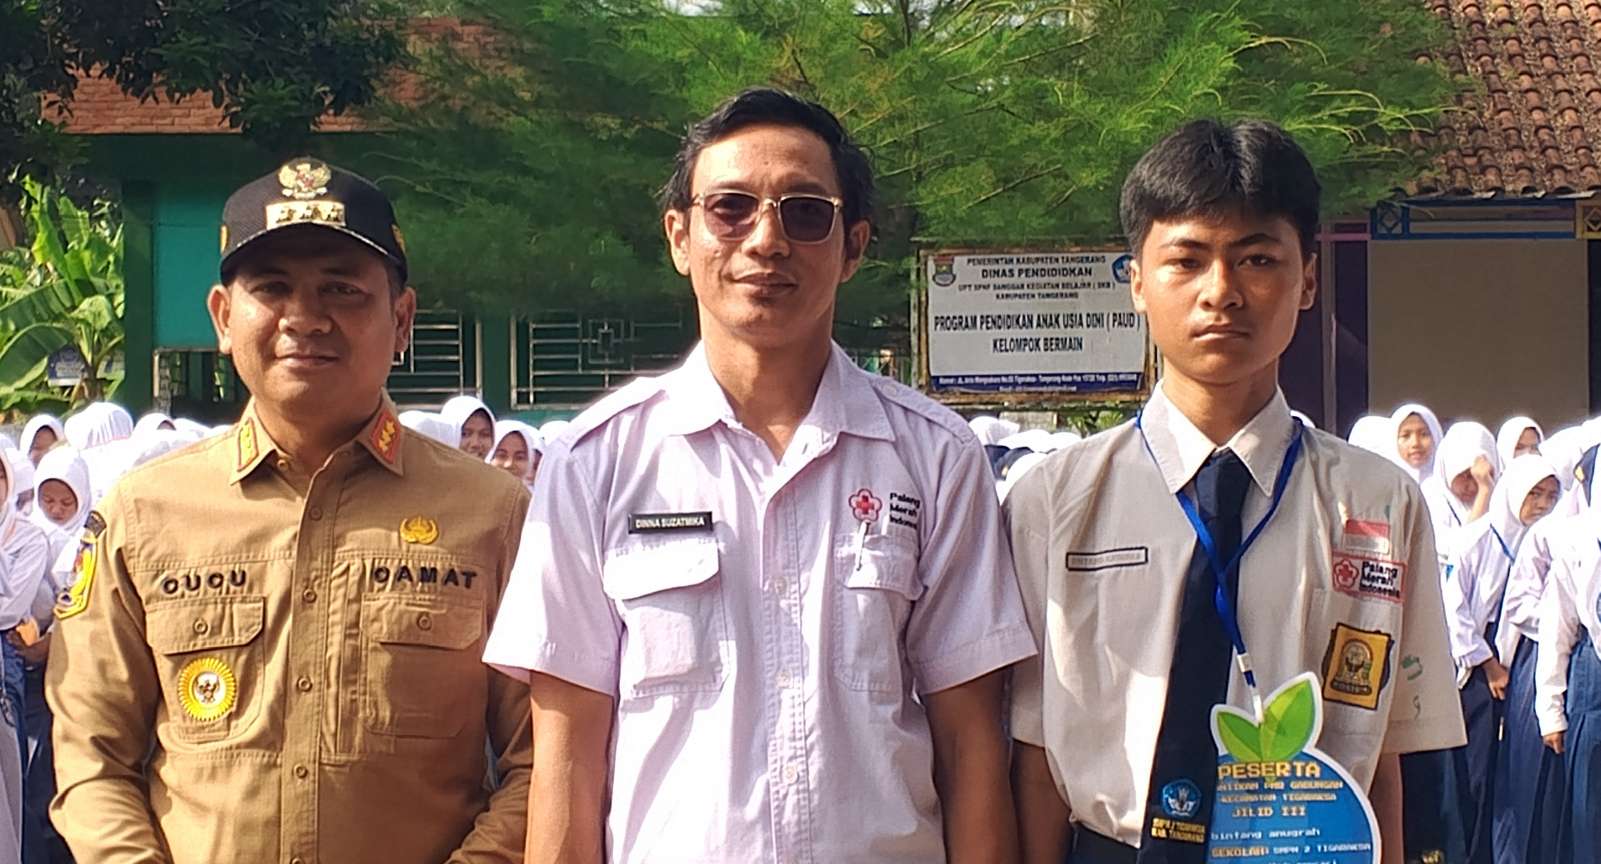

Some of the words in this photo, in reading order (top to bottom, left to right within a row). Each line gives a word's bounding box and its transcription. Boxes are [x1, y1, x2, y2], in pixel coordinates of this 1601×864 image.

[967, 257, 1014, 266] PEMERINTAH
[1016, 256, 1060, 265] KABUPATEN
[1061, 255, 1106, 264] TANGERANG
[981, 268, 1015, 279] DINAS
[1017, 266, 1093, 278] PENDIDIDKAN
[1037, 291, 1079, 299] TANGERANG
[934, 314, 978, 331] PROGRAM
[979, 313, 1034, 331] PENDIDIKAN
[1036, 313, 1060, 329] ANAK
[1062, 312, 1084, 329] USIA
[1086, 312, 1104, 329] DINI
[1112, 311, 1135, 329] PAUD
[992, 337, 1041, 353] KELOMPOK
[1043, 336, 1084, 352] BERMAIN
[889, 492, 921, 510] Palang
[889, 503, 918, 518] Merah
[635, 518, 660, 529] DINNA
[373, 565, 477, 590] CAMAT
[1361, 561, 1398, 579] Palang
[1361, 572, 1394, 587] Merah
[1359, 583, 1400, 599] Indonesia
[1217, 761, 1321, 780] PESERTA
[1232, 806, 1274, 818] JILID
[1281, 804, 1307, 817] III
[1210, 830, 1263, 841] bintang
[1268, 827, 1321, 838] anugrah
[1303, 845, 1311, 853] 2
